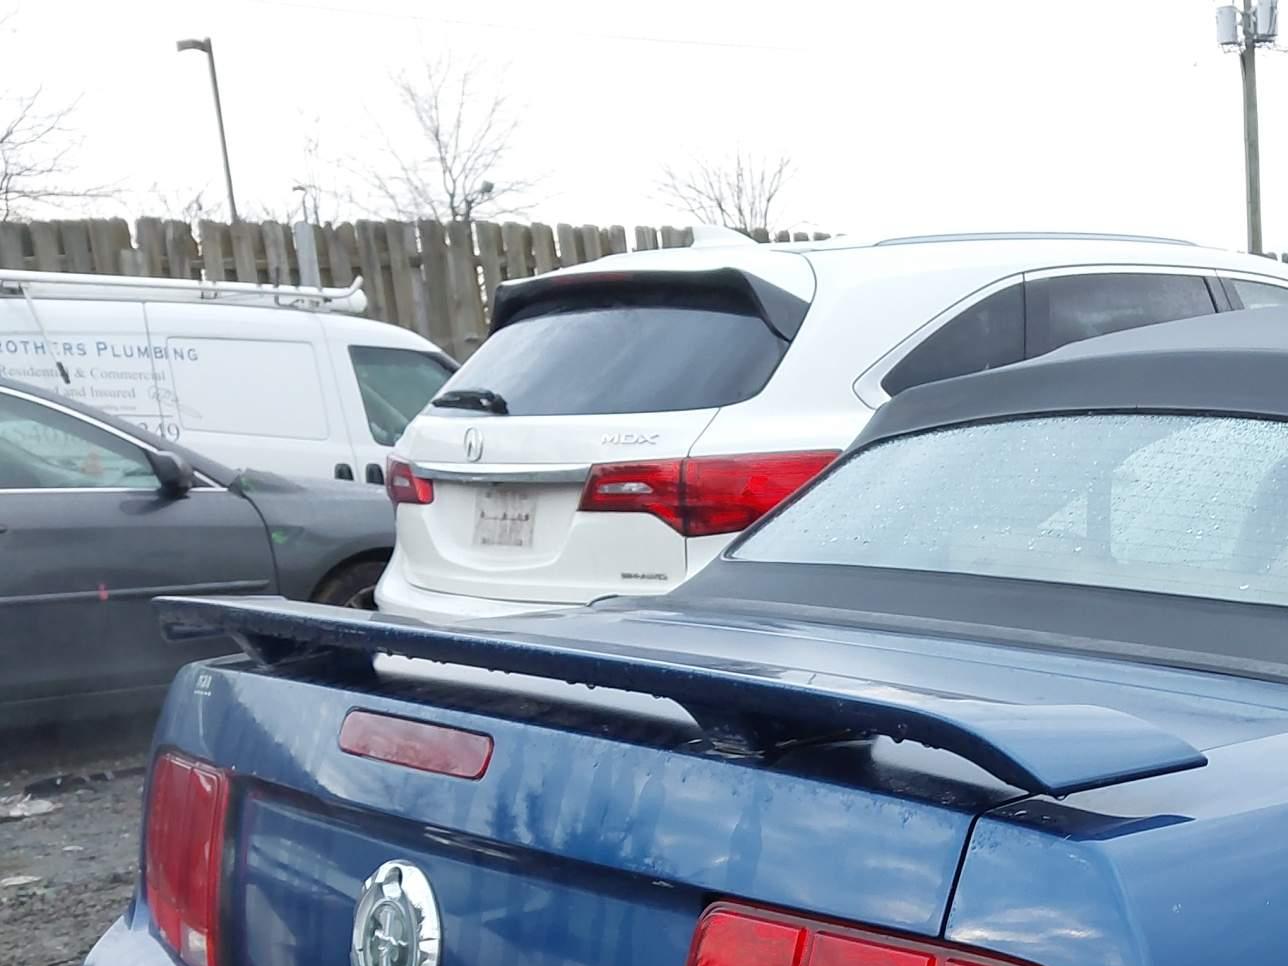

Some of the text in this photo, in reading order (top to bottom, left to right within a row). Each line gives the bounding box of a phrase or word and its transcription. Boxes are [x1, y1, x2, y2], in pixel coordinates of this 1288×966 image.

[0, 339, 199, 361] OTHRS PLUMBING
[600, 432, 660, 445] MDX
